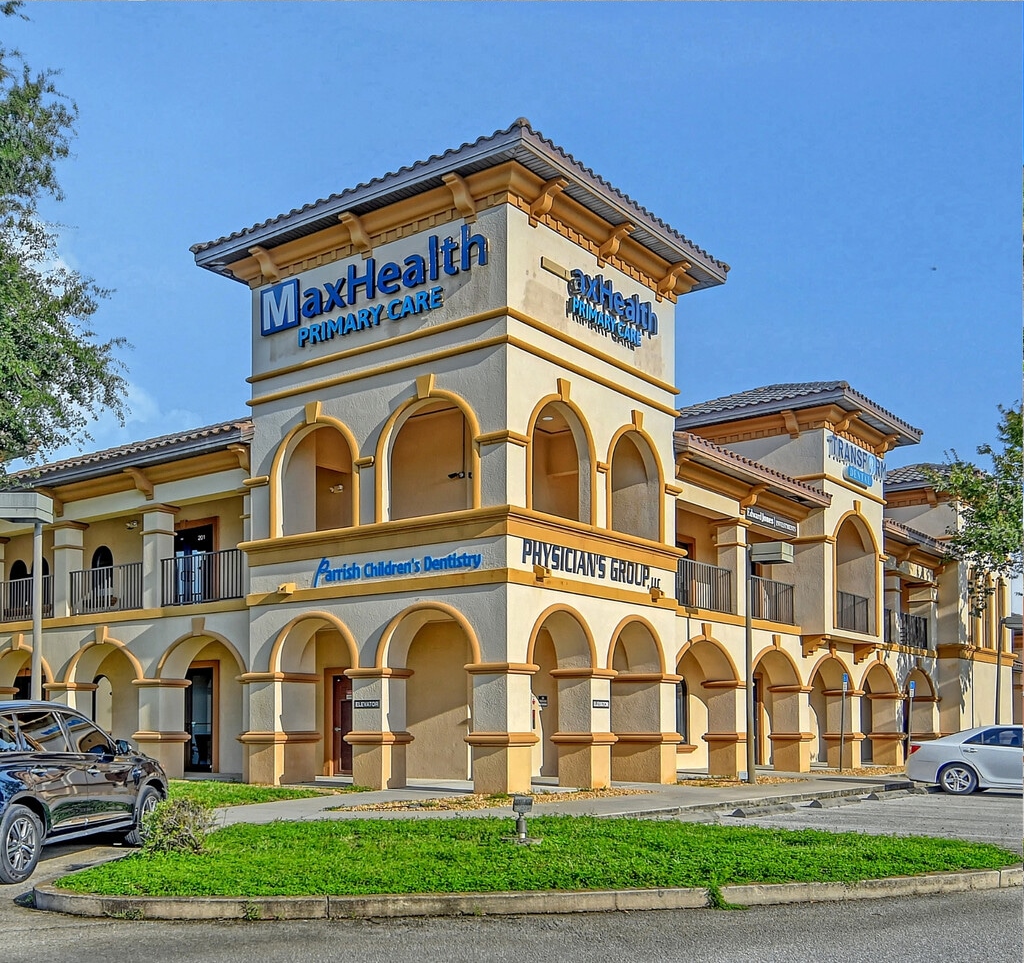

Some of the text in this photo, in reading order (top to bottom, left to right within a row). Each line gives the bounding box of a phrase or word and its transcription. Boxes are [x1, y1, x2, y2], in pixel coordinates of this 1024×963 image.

[261, 224, 489, 337] MaxHealth
[298, 286, 443, 348] PRIMARY CARE
[571, 296, 642, 347] PRIMARY CARE
[827, 434, 887, 480] TRANSFORM
[313, 553, 482, 588] Parrish Children's Dentistry
[522, 539, 606, 579] PHYSICIAN'S
[651, 577, 661, 589] LLC
